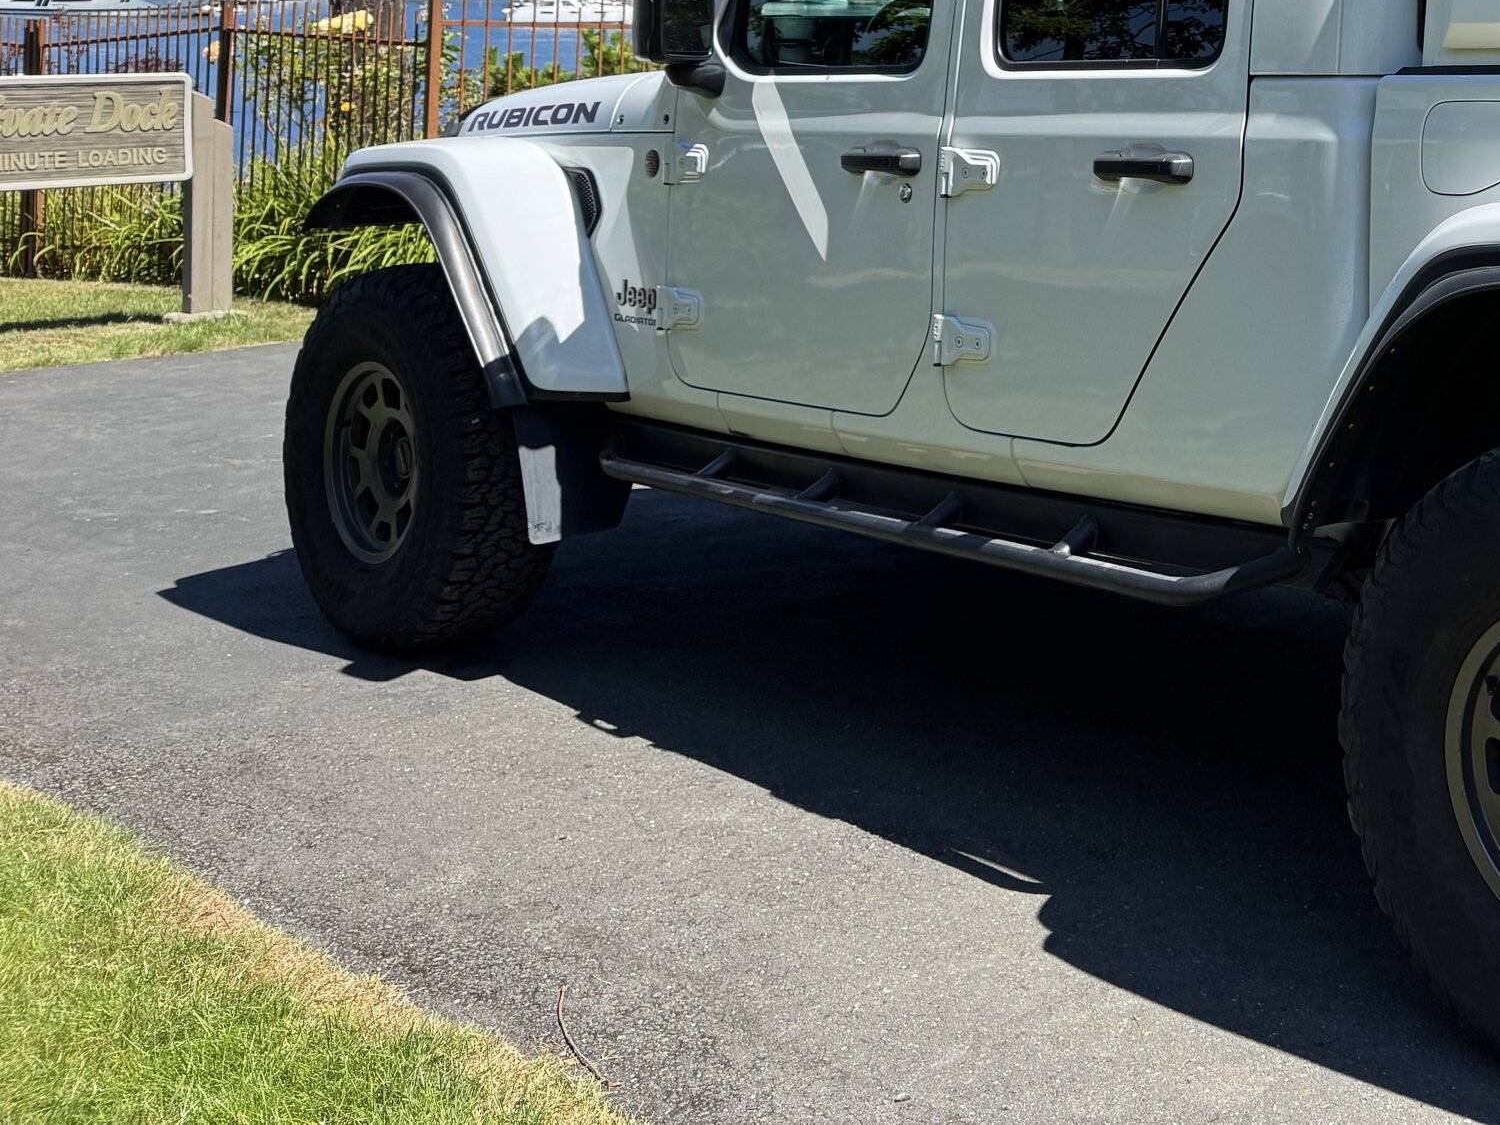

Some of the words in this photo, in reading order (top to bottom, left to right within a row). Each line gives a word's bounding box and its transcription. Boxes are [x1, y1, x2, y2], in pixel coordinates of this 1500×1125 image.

[84, 88, 179, 135] Dock
[467, 101, 602, 132] RUBICON
[0, 150, 67, 172] INUTE
[78, 146, 167, 168] LOADING
[616, 279, 657, 315] Jeep
